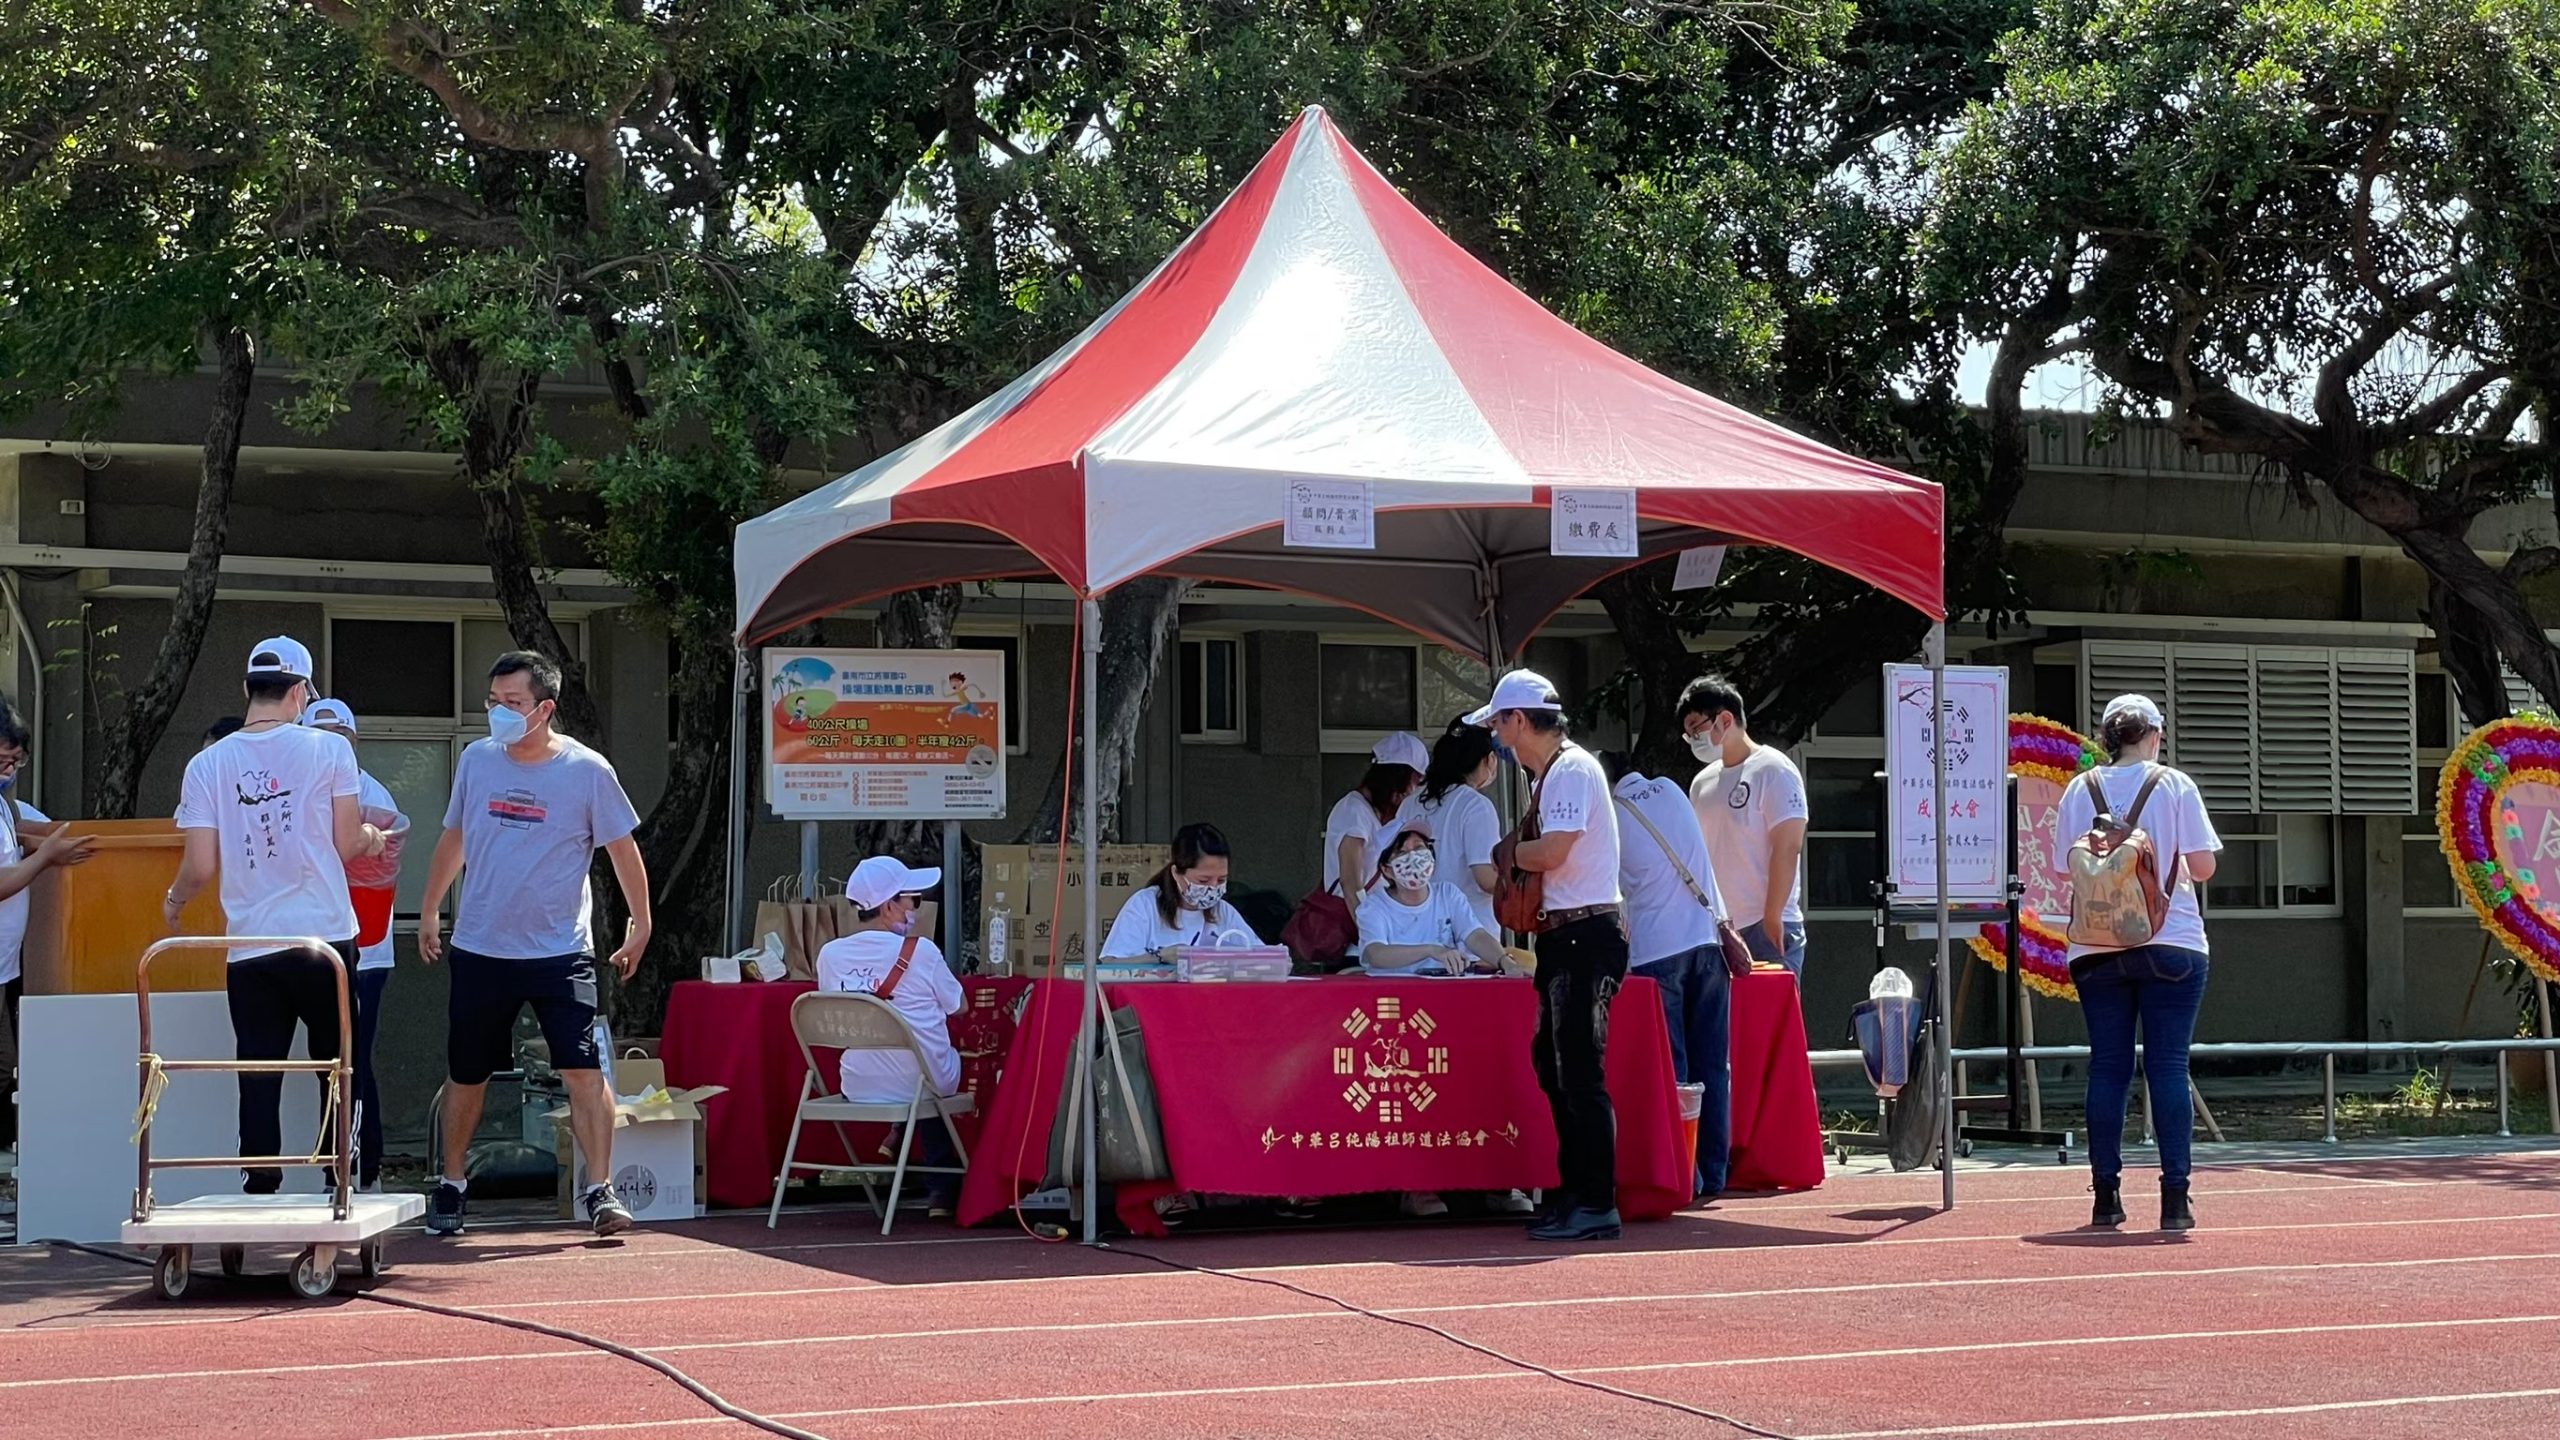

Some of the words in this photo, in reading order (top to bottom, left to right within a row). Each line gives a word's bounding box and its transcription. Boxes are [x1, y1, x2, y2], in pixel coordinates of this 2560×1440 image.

[1568, 521, 1619, 540] 繳費處
[1903, 777, 1995, 790] 中華呂純祖師道法協會
[1917, 798, 1980, 819] 成大會
[1920, 833, 1981, 847] 第一會員大會
[1066, 871, 1130, 887] 小輕放
[1291, 1129, 1490, 1149] 中華呂純陽祖師道法協會
